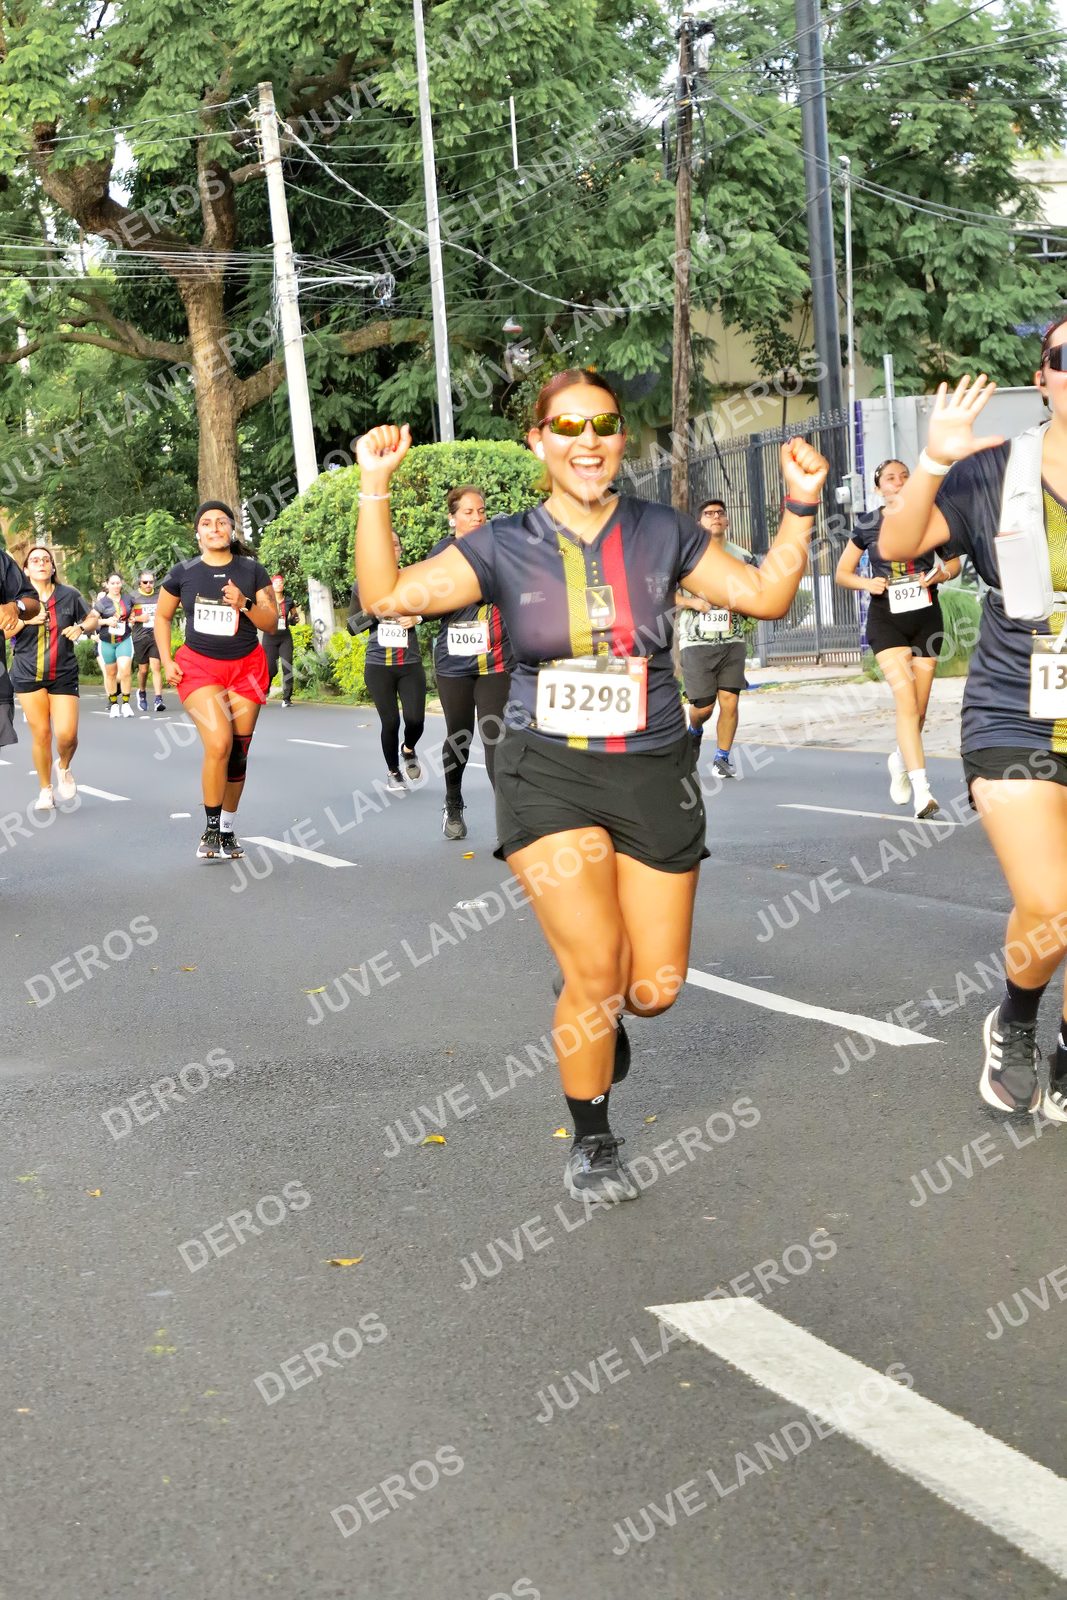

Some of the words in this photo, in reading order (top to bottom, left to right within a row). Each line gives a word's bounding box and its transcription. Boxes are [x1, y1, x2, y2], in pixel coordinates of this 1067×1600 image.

[895, 586, 922, 600] 8927
[197, 609, 232, 622] 12118
[703, 613, 728, 622] 13380
[380, 627, 407, 638] 12628
[450, 633, 483, 644] 12062
[545, 683, 631, 713] 13298
